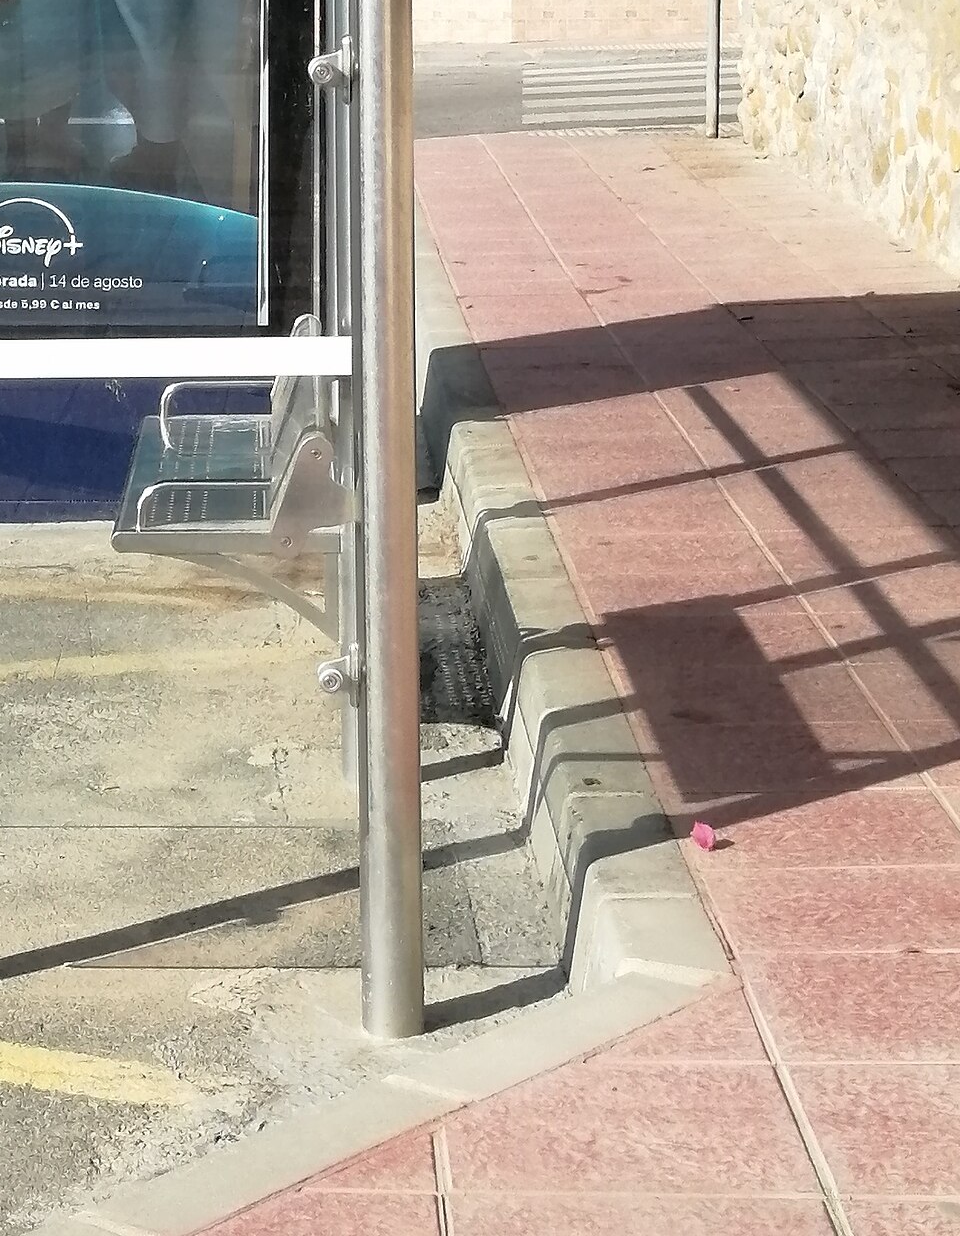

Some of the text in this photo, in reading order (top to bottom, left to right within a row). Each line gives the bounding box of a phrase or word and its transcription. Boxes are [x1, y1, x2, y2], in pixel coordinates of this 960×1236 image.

[49, 274, 66, 288] 14
[70, 274, 90, 288] de
[93, 275, 143, 291] agosto
[21, 299, 47, 310] 5,99
[62, 299, 73, 310] al
[75, 300, 100, 310] mes
